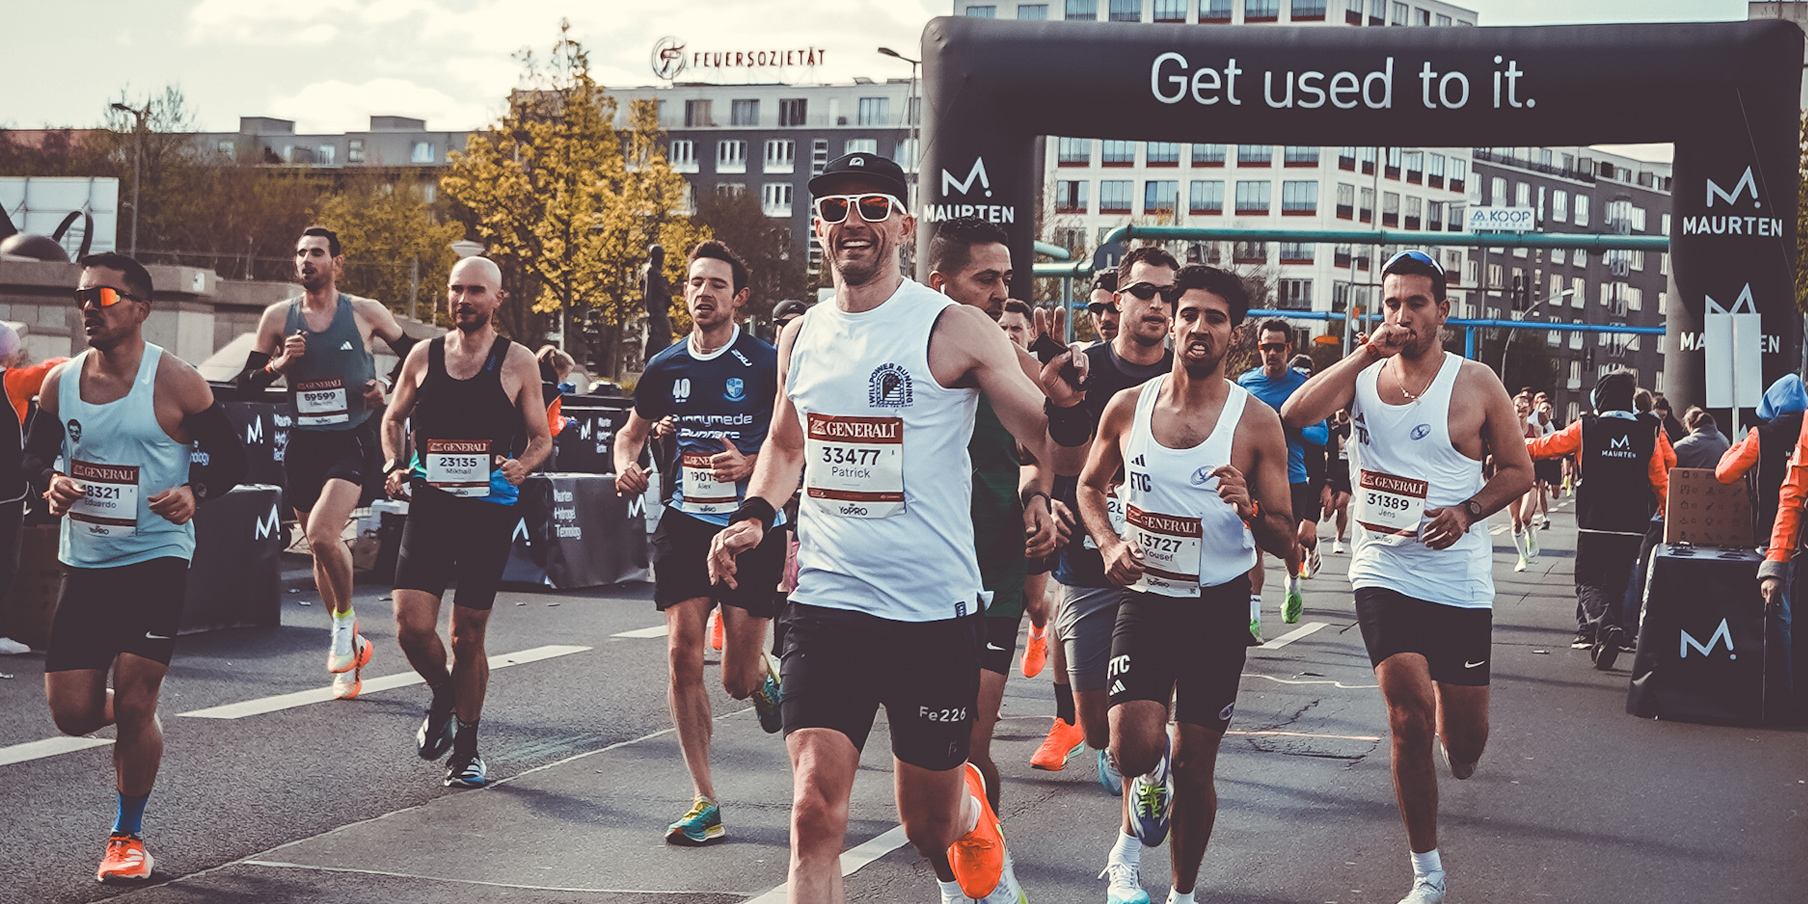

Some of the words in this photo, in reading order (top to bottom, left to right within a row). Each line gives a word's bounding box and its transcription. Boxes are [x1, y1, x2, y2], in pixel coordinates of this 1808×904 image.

[1151, 51, 1242, 105] Get
[1264, 56, 1394, 109] used
[1418, 61, 1470, 109] to
[1493, 54, 1536, 109] it.
[923, 204, 1014, 223] MAURTEN
[1490, 210, 1531, 222] KOOP
[1682, 215, 1783, 237] MAURTEN
[1679, 331, 1780, 354] MAEN
[672, 378, 691, 398] 40
[868, 362, 895, 404] WILLPOWER
[896, 365, 914, 404] RUNNING
[304, 392, 336, 402] 59599
[826, 421, 897, 438] GENERALI
[443, 442, 487, 452] GENERALI
[1601, 450, 1637, 459] MAURTEN
[439, 457, 477, 467] 23135
[822, 446, 881, 466] 33477
[84, 466, 135, 481] GENERALI
[446, 467, 472, 475] Mikhail
[691, 471, 716, 481] 1901
[831, 465, 871, 479] Patrick
[1130, 471, 1152, 493] FTC
[1374, 476, 1424, 495] GENERALI
[84, 498, 117, 509] Eduardo
[1367, 492, 1409, 511] 31389
[838, 505, 869, 517] YoPRO
[1141, 512, 1198, 534] GENERALI
[1138, 532, 1183, 553] 13727
[1143, 548, 1174, 562] Yousef
[919, 705, 967, 722] Fe226
